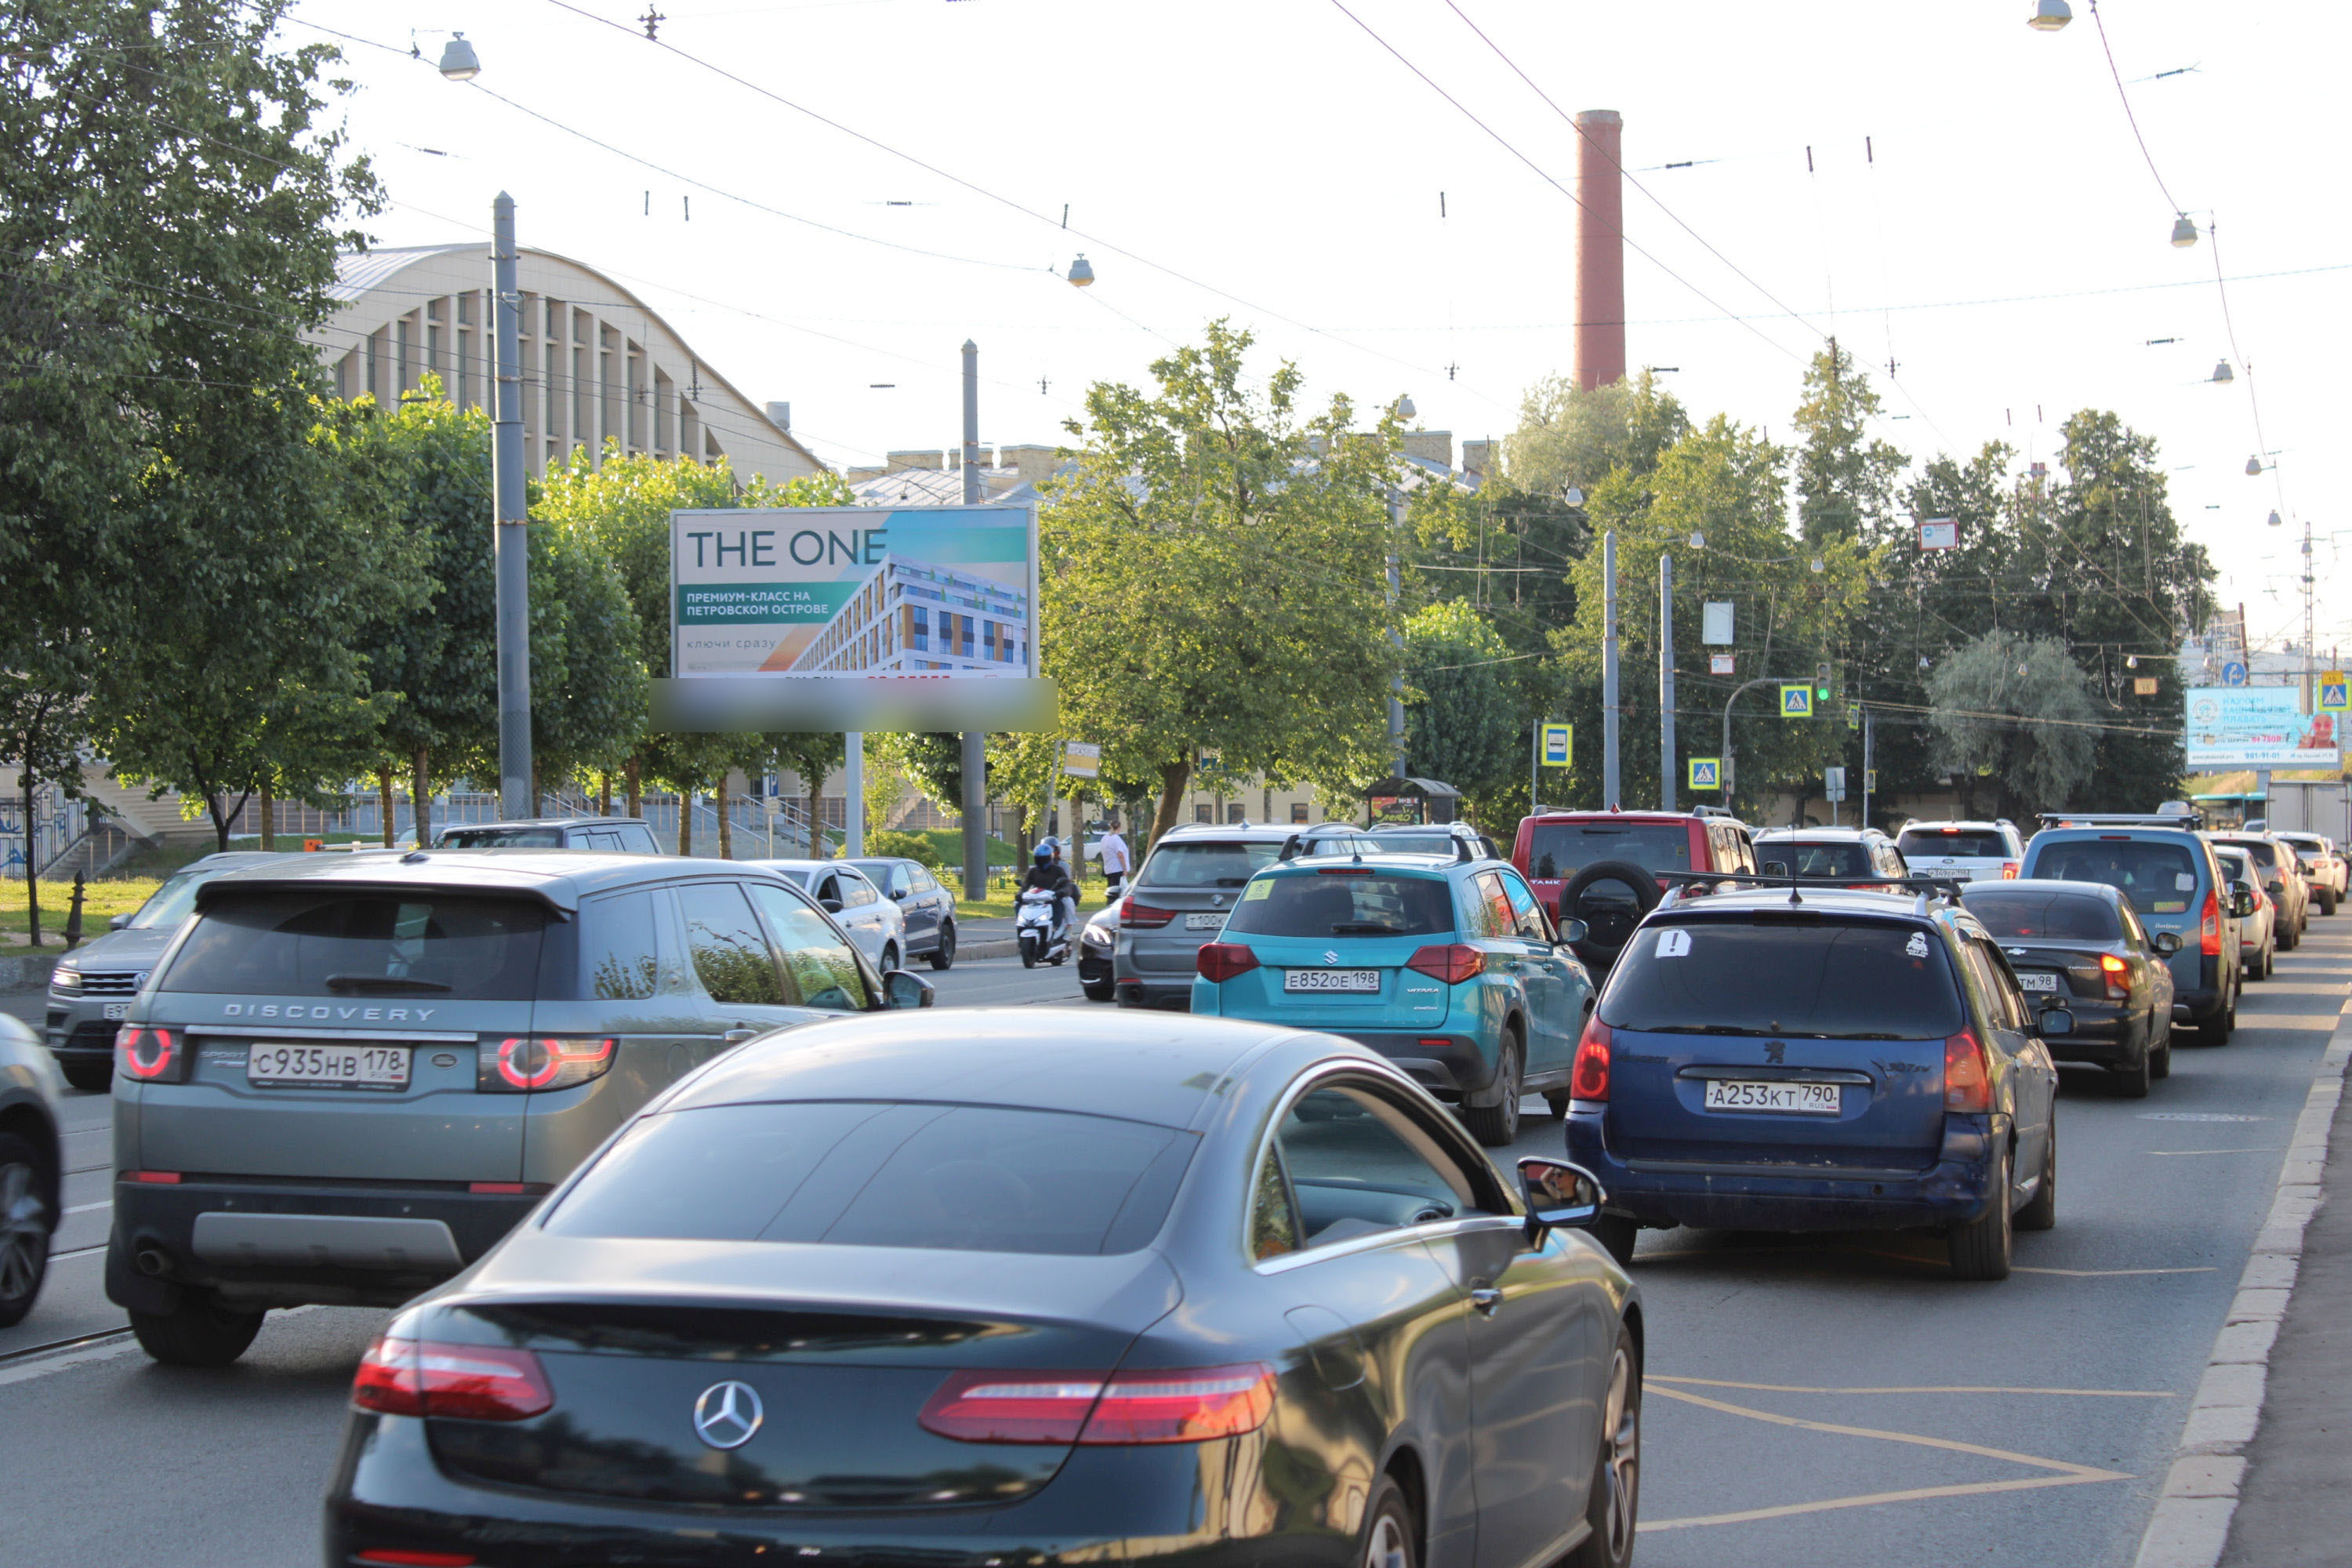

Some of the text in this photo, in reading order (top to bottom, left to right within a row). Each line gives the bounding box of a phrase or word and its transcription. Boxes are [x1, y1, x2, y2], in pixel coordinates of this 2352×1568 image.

[687, 528, 888, 567] THE ONE
[686, 591, 811, 603] ПРЕМИУМ-КЛАСС НА
[686, 604, 829, 616] ПЕТРОВСКОМ ОСТРОВЕ
[687, 638, 776, 650] ключи сразу
[2245, 751, 2280, 760] 981-91-01
[1290, 972, 1376, 988] Е852ОЕ 198
[2038, 975, 2053, 986] 98
[223, 1004, 437, 1022] DISCOVERY
[257, 1048, 401, 1077] С935НВ 178
[1712, 1083, 1835, 1107] А253КТ 790
